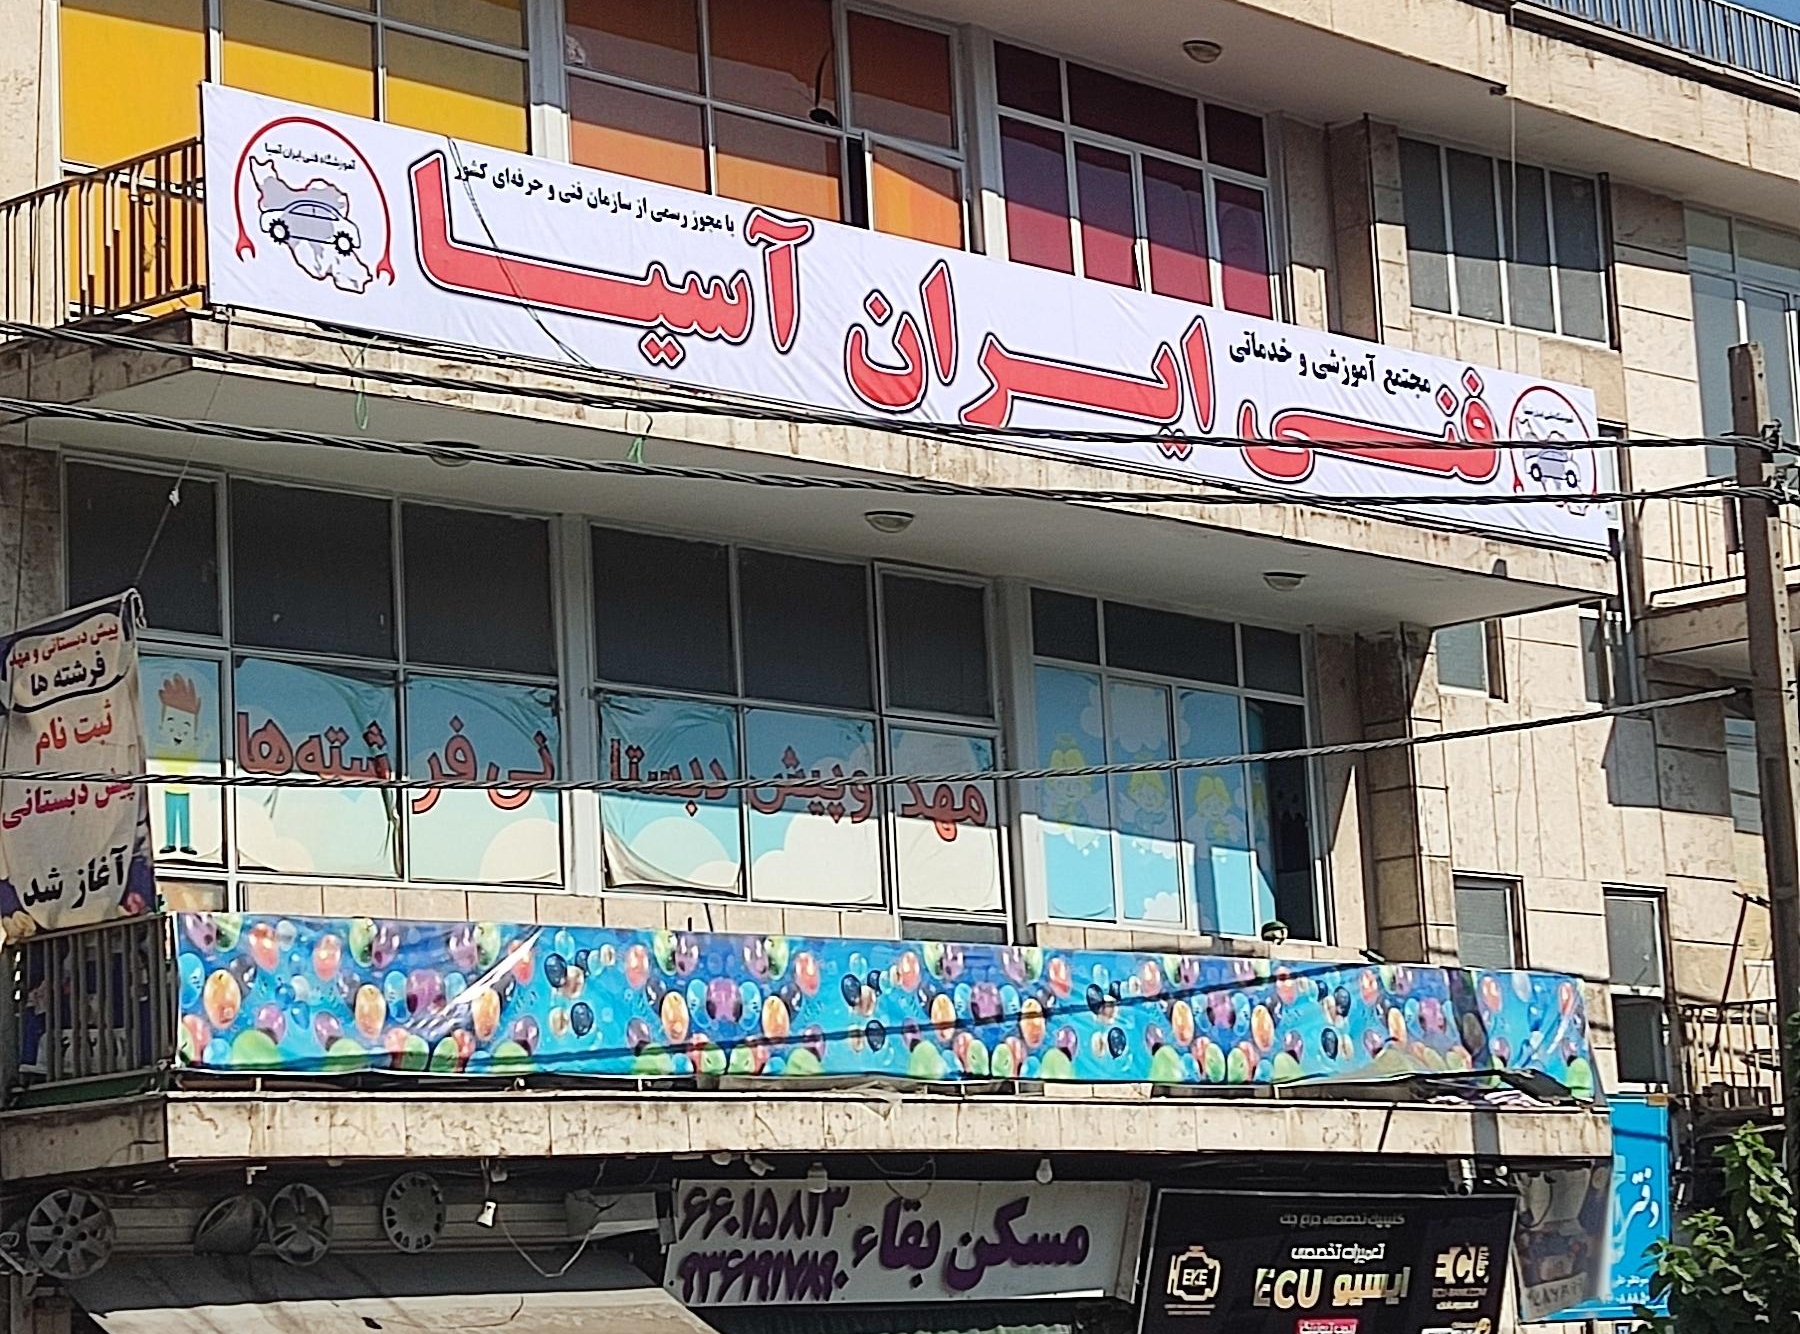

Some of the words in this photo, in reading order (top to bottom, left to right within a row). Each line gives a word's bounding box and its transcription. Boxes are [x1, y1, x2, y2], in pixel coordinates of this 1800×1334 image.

[454, 161, 488, 181] کشور
[548, 184, 555, 200] و
[558, 182, 583, 202] فنی
[587, 187, 632, 213] سازمان
[636, 197, 648, 218] از
[650, 209, 689, 228] رسمی
[692, 210, 724, 233] مجوز
[725, 215, 735, 237] با
[408, 149, 816, 369] آسیا
[845, 260, 1216, 461] ایران
[1229, 331, 1292, 363] خدماتی
[1299, 353, 1307, 376] و
[1312, 349, 1375, 387] آموزشی
[1383, 369, 1431, 399] مجتمع
[1237, 367, 1501, 485] فنی
[42, 632, 88, 661] دبستانی
[91, 622, 118, 645] پیش
[9, 651, 30, 668] مهد
[33, 648, 39, 664] و
[53, 650, 106, 687] فرشته
[31, 673, 48, 696] ها
[74, 698, 113, 745] ثبت
[36, 716, 67, 765] نام
[95, 767, 136, 808] پیش
[2, 783, 89, 829] دبستانی
[900, 782, 989, 843] مهد
[23, 867, 63, 907] شد
[71, 844, 128, 909] آغاز
[852, 1195, 942, 1290] بقاء
[942, 1195, 1090, 1292] مسکن
[1291, 1243, 1342, 1260] تخصصی
[1341, 1243, 1385, 1264] تعمیرات
[1253, 1268, 1323, 1309] ECU
[1332, 1267, 1411, 1306] ایسیو
